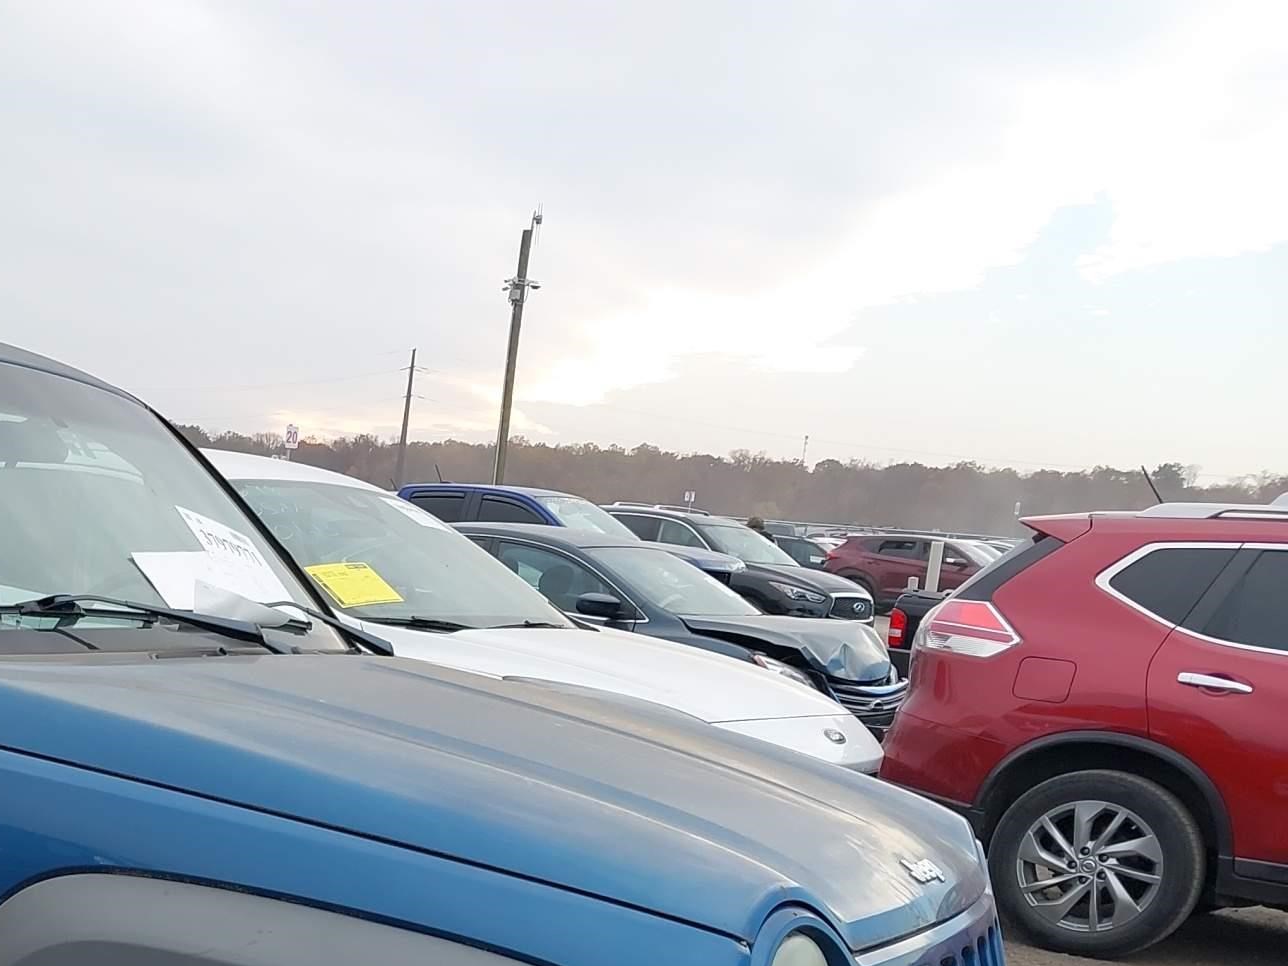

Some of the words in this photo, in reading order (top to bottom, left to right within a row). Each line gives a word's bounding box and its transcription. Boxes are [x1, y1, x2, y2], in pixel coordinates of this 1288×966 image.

[286, 430, 298, 444] 20
[200, 529, 262, 566] 37979771
[900, 858, 945, 882] Jeep
